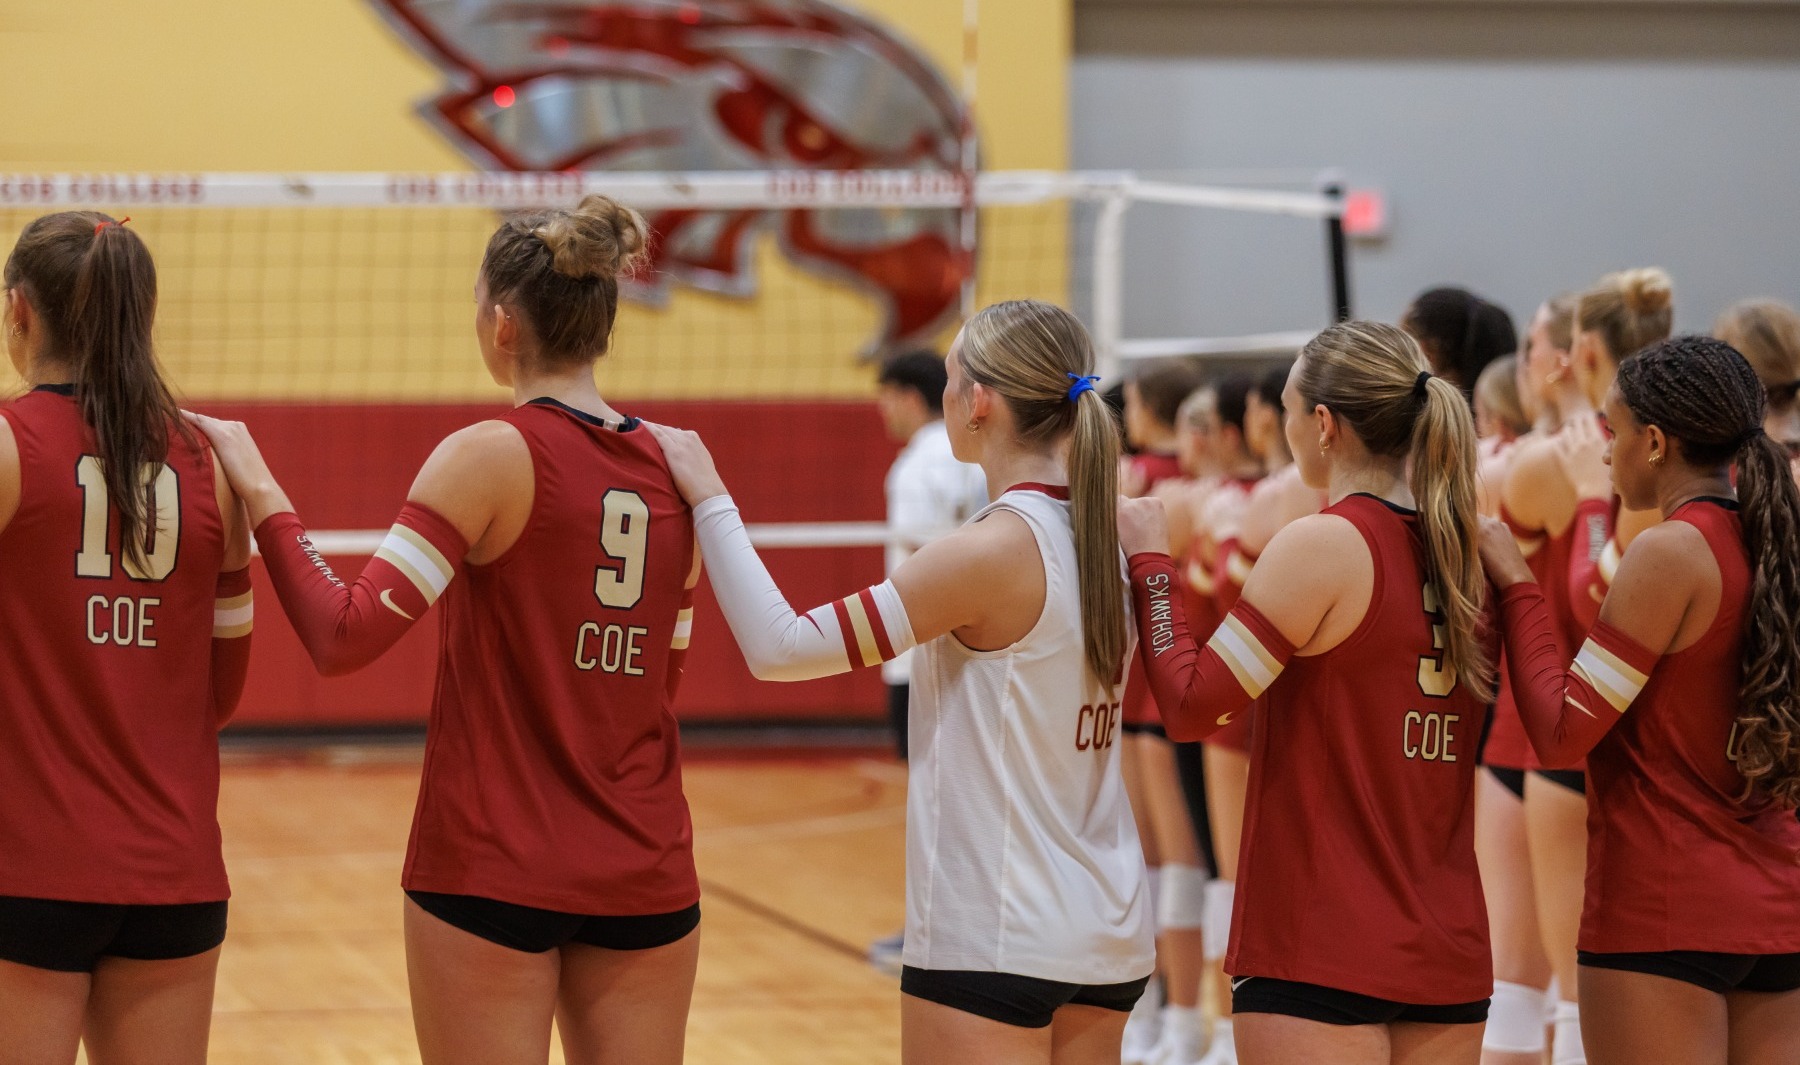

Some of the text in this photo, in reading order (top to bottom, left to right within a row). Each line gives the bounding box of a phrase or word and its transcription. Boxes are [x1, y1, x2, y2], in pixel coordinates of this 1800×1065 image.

[75, 454, 181, 583] 10
[593, 487, 649, 611] 9
[86, 594, 162, 648] COE
[1146, 573, 1175, 658] KOHAWKS
[574, 621, 648, 677] COE
[1075, 702, 1120, 751] COE
[1403, 710, 1460, 762] COE
